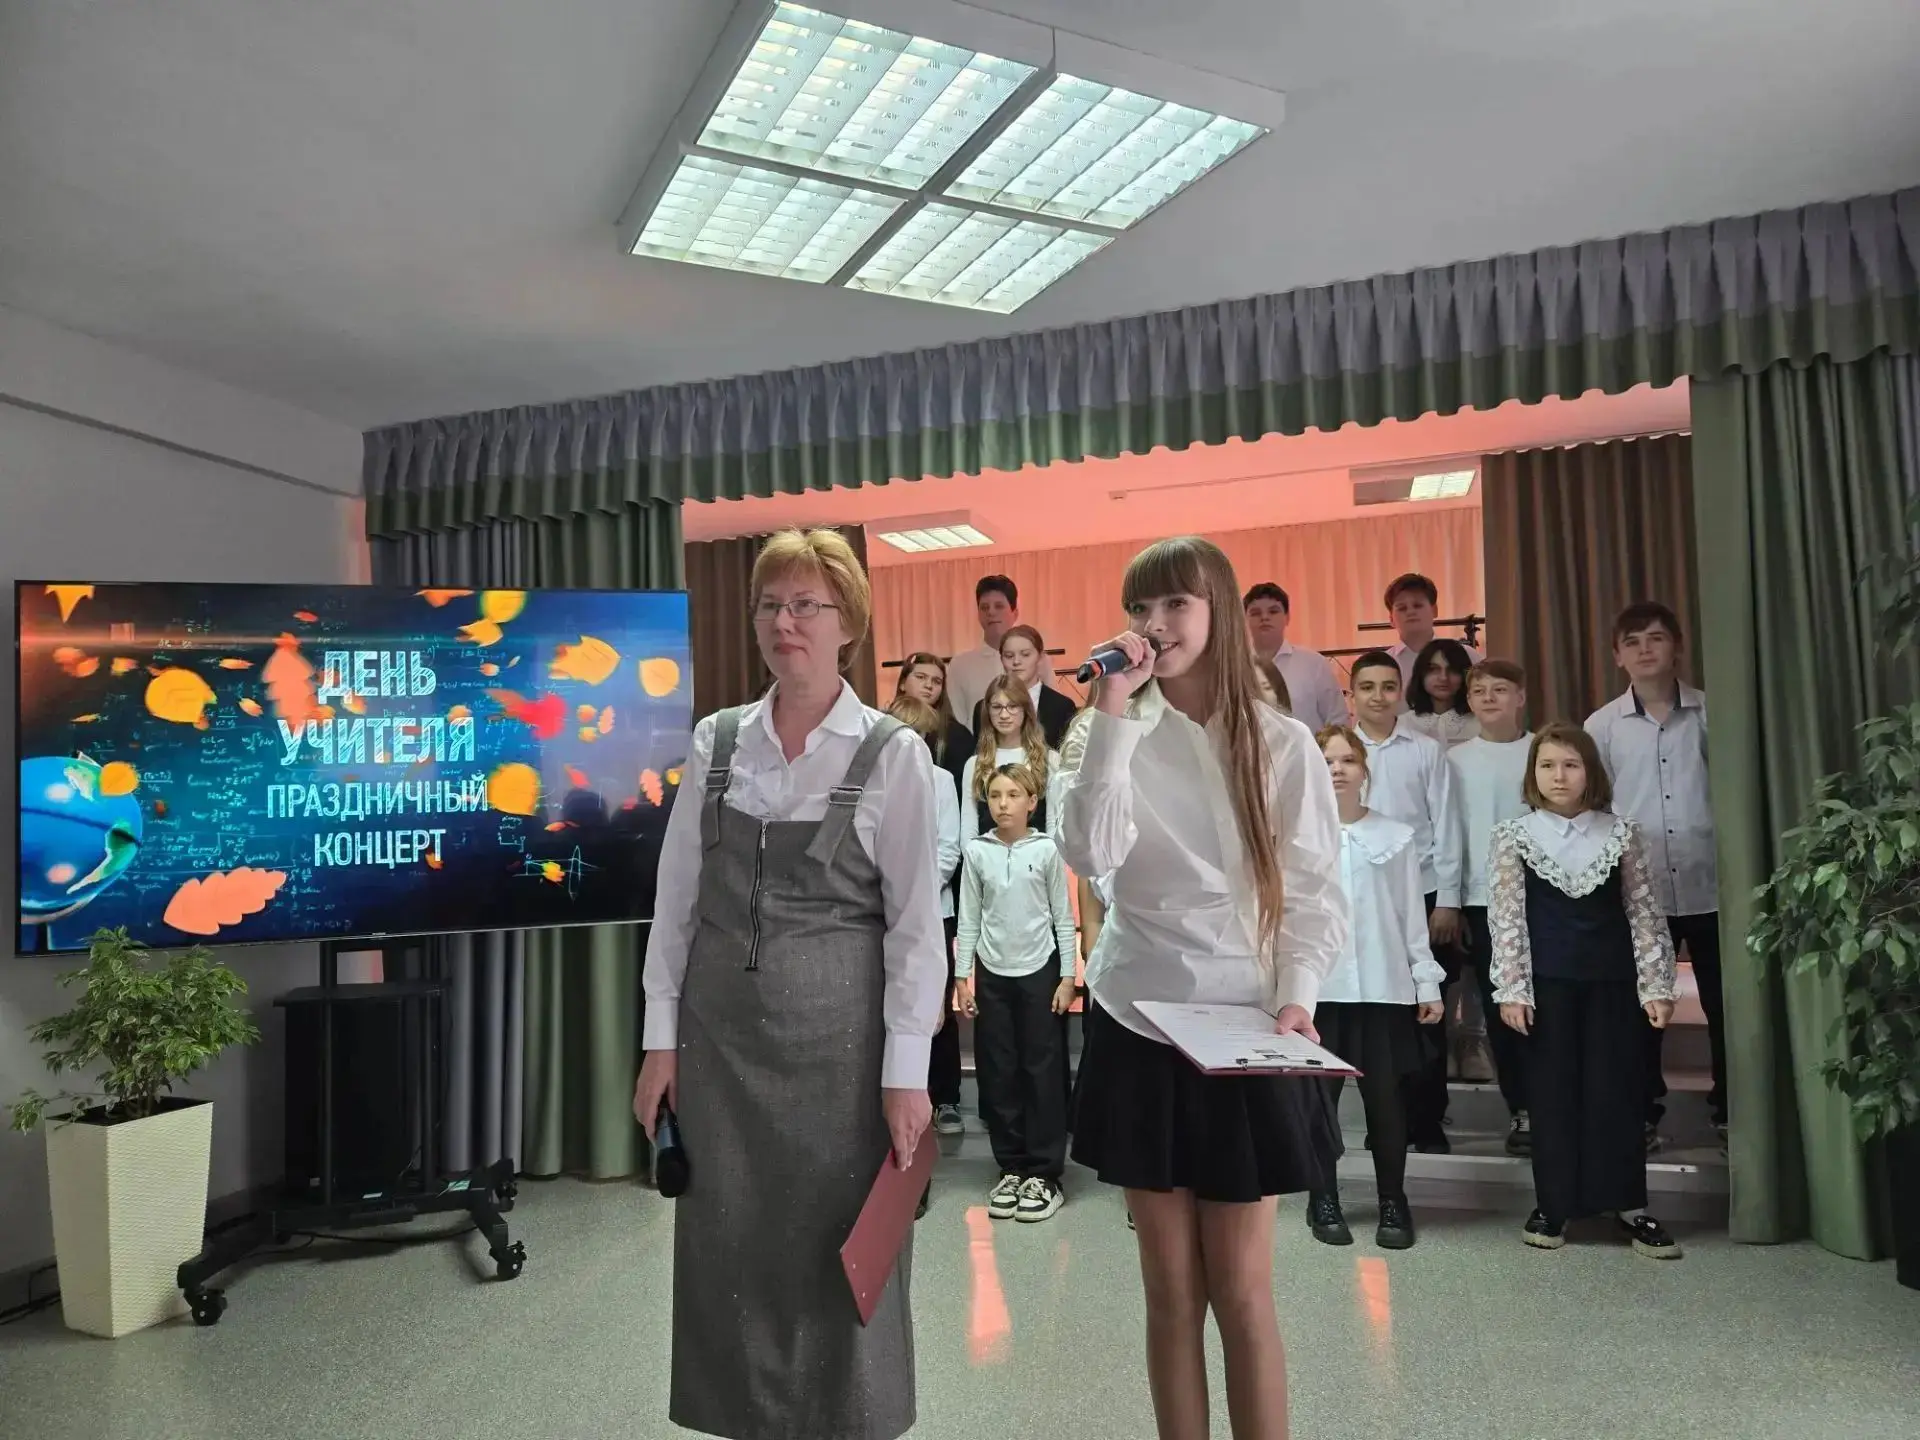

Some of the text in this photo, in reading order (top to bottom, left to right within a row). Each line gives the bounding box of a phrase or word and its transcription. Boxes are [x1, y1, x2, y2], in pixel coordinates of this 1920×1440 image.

[318, 651, 437, 704] ДЕНЬ
[277, 717, 475, 766] УЧИТЕЛЯ
[267, 774, 488, 821] ПРАЗДНИЧНЫЙ
[314, 829, 446, 869] КОНЦЕРТ
